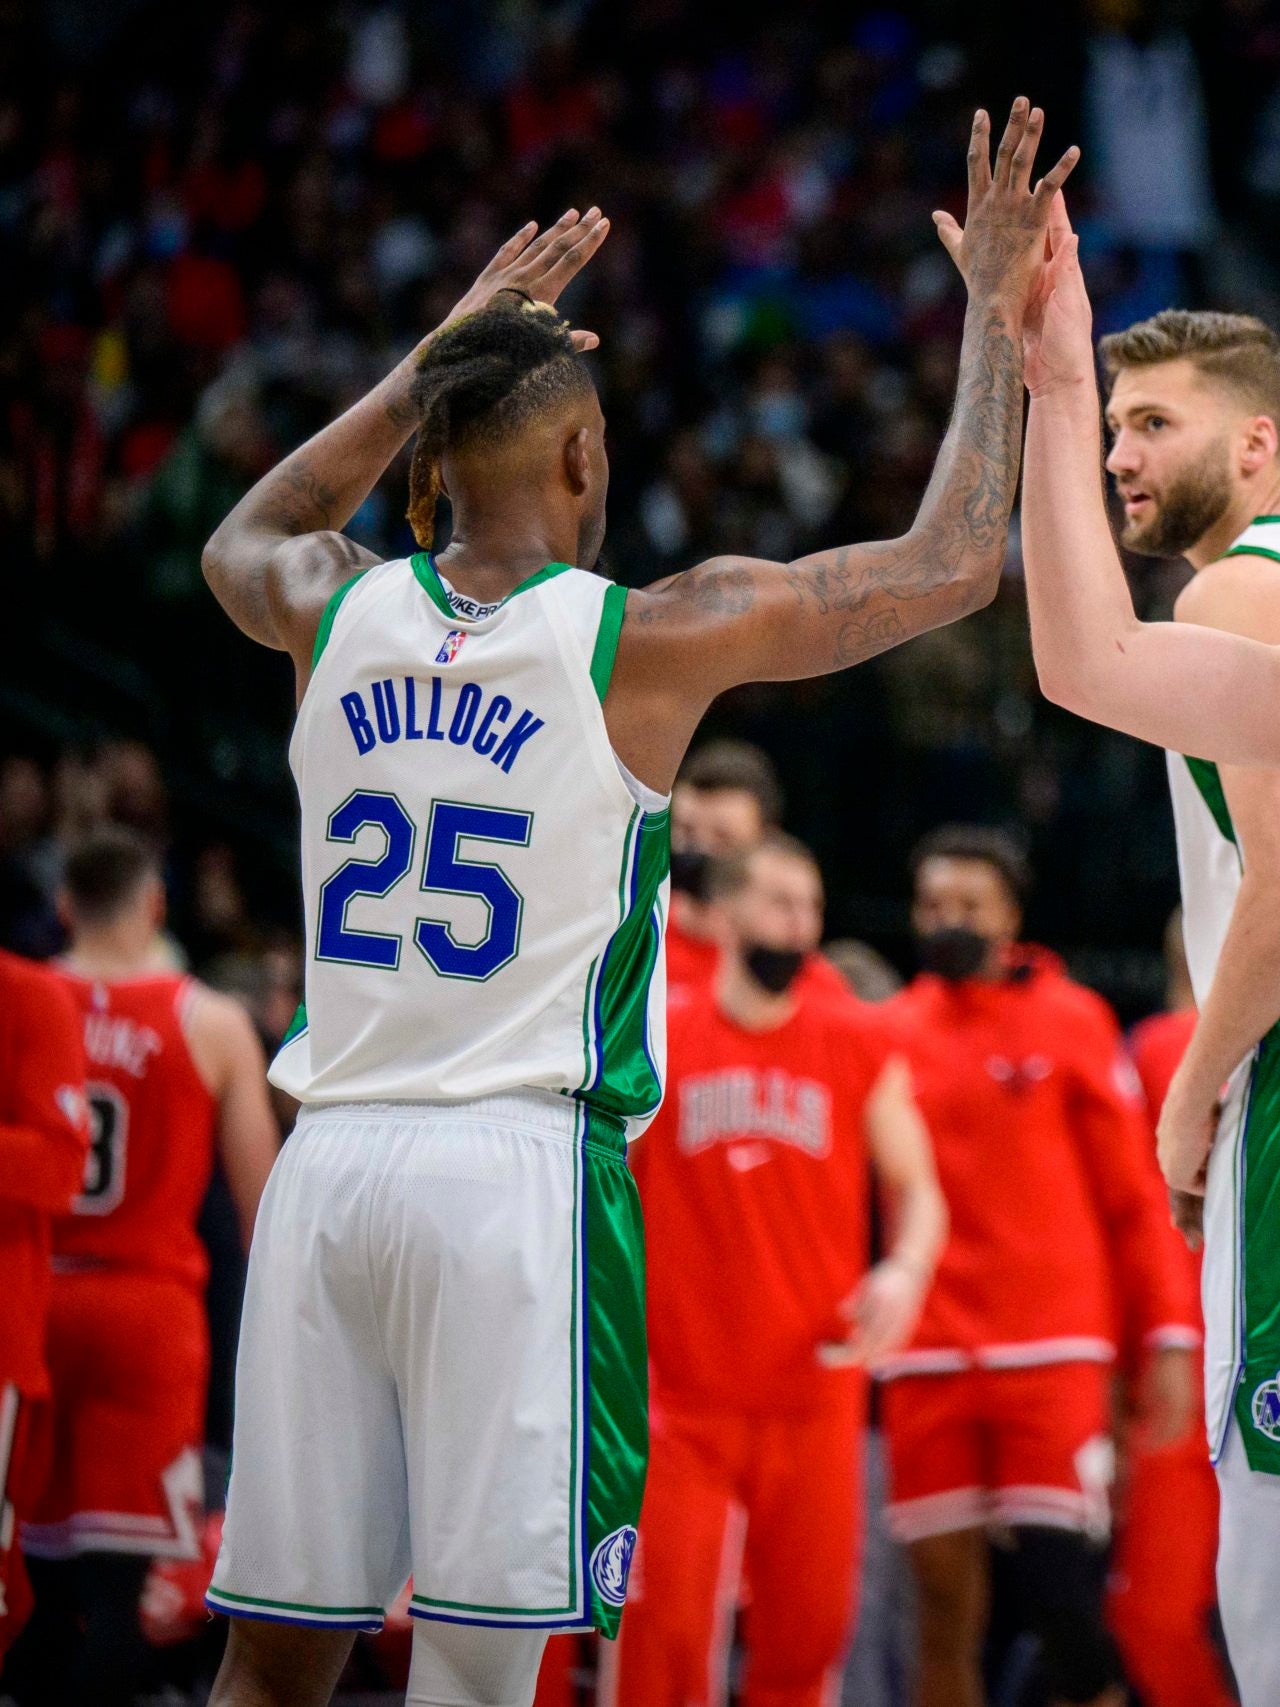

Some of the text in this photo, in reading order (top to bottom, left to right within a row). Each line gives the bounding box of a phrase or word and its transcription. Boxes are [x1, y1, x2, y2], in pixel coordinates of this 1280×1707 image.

[446, 591, 500, 618] NIKE PR
[340, 676, 545, 774] BULLOCK
[315, 788, 534, 982] 25
